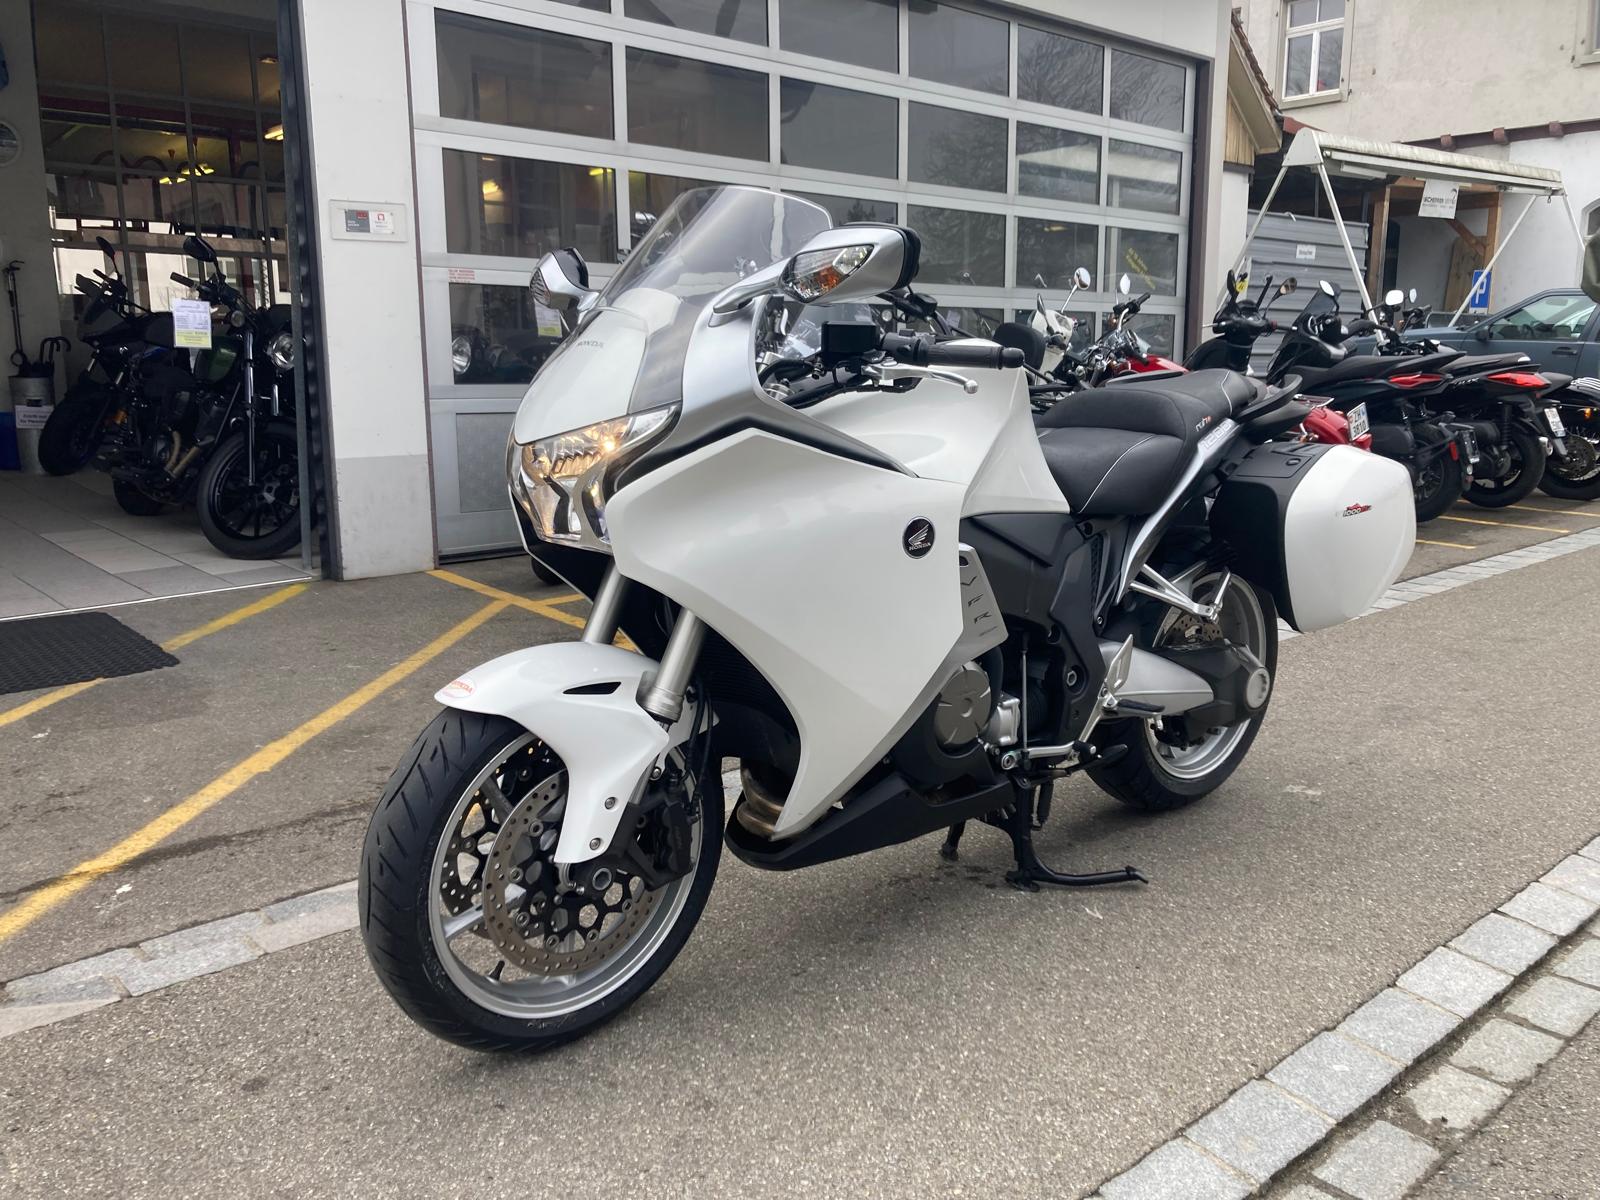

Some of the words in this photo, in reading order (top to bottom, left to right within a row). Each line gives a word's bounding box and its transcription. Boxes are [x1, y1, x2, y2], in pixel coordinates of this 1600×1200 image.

[1475, 276, 1487, 305] P
[1199, 418, 1233, 449] 1200
[908, 541, 931, 551] HONDA
